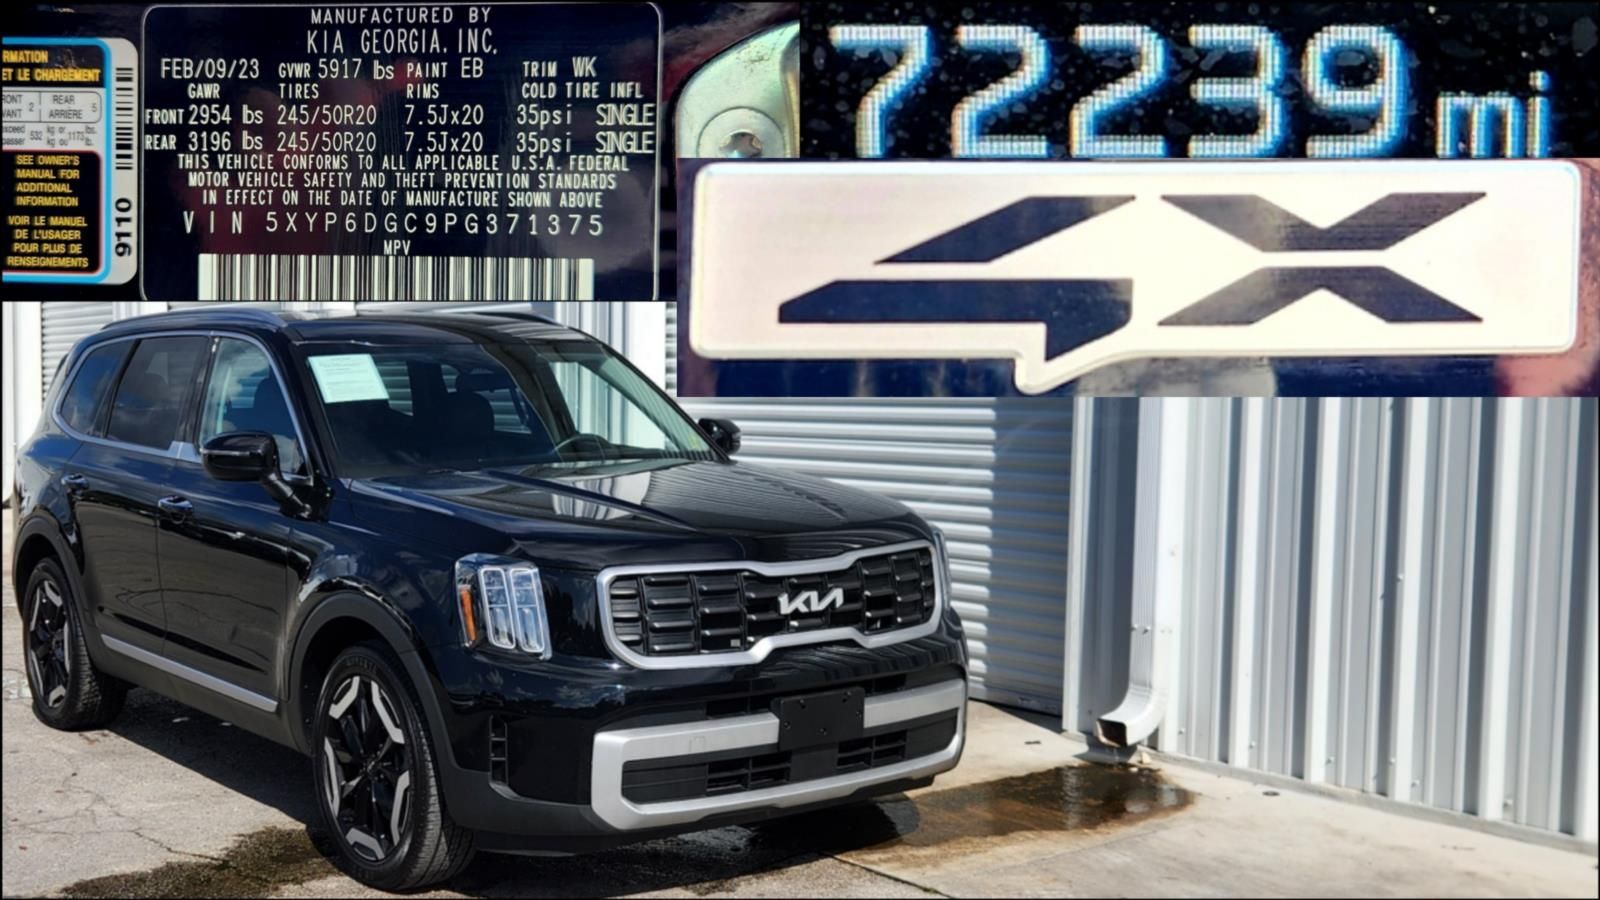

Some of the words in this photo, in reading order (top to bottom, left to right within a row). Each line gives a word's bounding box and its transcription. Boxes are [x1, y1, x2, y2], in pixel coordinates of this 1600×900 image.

[310, 7, 453, 24] MANUFACTURED
[469, 7, 491, 23] BY
[307, 29, 344, 54] KIA
[458, 28, 497, 54] INC.
[2, 68, 13, 80] ET
[17, 69, 30, 80] LE
[35, 69, 100, 82] CHARGEMENT
[161, 58, 259, 78] FEB/09/23
[278, 63, 310, 78] GVWR
[318, 59, 362, 78] 5917
[373, 60, 394, 79] lbs
[407, 62, 448, 77] PAINT
[461, 57, 483, 78] EB
[523, 61, 557, 77] TRIM
[573, 56, 597, 77] WK
[188, 83, 220, 99] GAWR
[279, 84, 319, 99] TIRES
[407, 83, 439, 99] RIMS
[522, 82, 557, 98] COLD
[566, 82, 600, 98] TIRE
[611, 82, 644, 98] INFL
[829, 24, 1410, 157] 72239
[1436, 70, 1553, 157] mi
[53, 95, 75, 104] REAR
[145, 109, 184, 125] FRONT
[188, 104, 232, 124] 2954
[243, 105, 263, 125] lbs
[277, 105, 376, 125] 245/50R20
[405, 104, 484, 125] 7.5Jx20
[517, 104, 571, 130] 35psi
[596, 104, 655, 126] SINGLE
[145, 135, 176, 150] REAR
[188, 132, 231, 151] 3196
[242, 131, 263, 151] lbs
[277, 132, 376, 152] 245/50R20
[405, 132, 483, 152] 7.5Jx20
[517, 132, 571, 158] 35psi
[596, 131, 655, 153] SINGLE
[16, 155, 34, 164] SEE
[38, 155, 79, 165] OWNER'S
[178, 154, 209, 169] THIS
[218, 155, 274, 169] VEHICLE
[283, 155, 348, 169] CONFORMS
[358, 155, 373, 170] TO
[383, 155, 405, 170] ALL
[415, 155, 499, 171] APPLICABLE
[512, 156, 561, 171] U.S.A.
[570, 156, 629, 171] FEDERAL
[16, 169, 56, 179] MANUAL
[60, 169, 79, 179] FOR
[189, 172, 229, 186] MOTOR
[238, 173, 294, 187] VEHICLE
[304, 173, 351, 187] SAFETY
[361, 173, 385, 187] AND
[395, 173, 434, 188] THEFT
[445, 174, 529, 189] PREVENTION
[538, 174, 617, 189] STANDARDS
[16, 183, 72, 192] ADDITIONAL
[16, 197, 78, 206] INFORMATION
[203, 191, 216, 204] IN
[226, 191, 273, 205] EFFECT
[283, 191, 298, 205] ON
[308, 191, 331, 205] THE
[340, 191, 372, 206] DATE
[381, 191, 397, 206] OF
[406, 191, 498, 207] MANUFACTURE
[508, 192, 550, 207] SHOWN
[560, 192, 603, 208] ABOVE
[8, 216, 30, 225] VOIR
[34, 216, 46, 225] LE
[50, 216, 87, 226] MANUEL
[115, 198, 132, 256] 9110
[15, 230, 28, 239] DE
[34, 230, 80, 239] L'USAGER
[13, 243, 38, 252] POUR
[43, 243, 65, 253] PLUS
[69, 244, 82, 253] DE
[384, 239, 411, 256] MPV
[7, 256, 88, 267] RENSEIGNEMENTS
